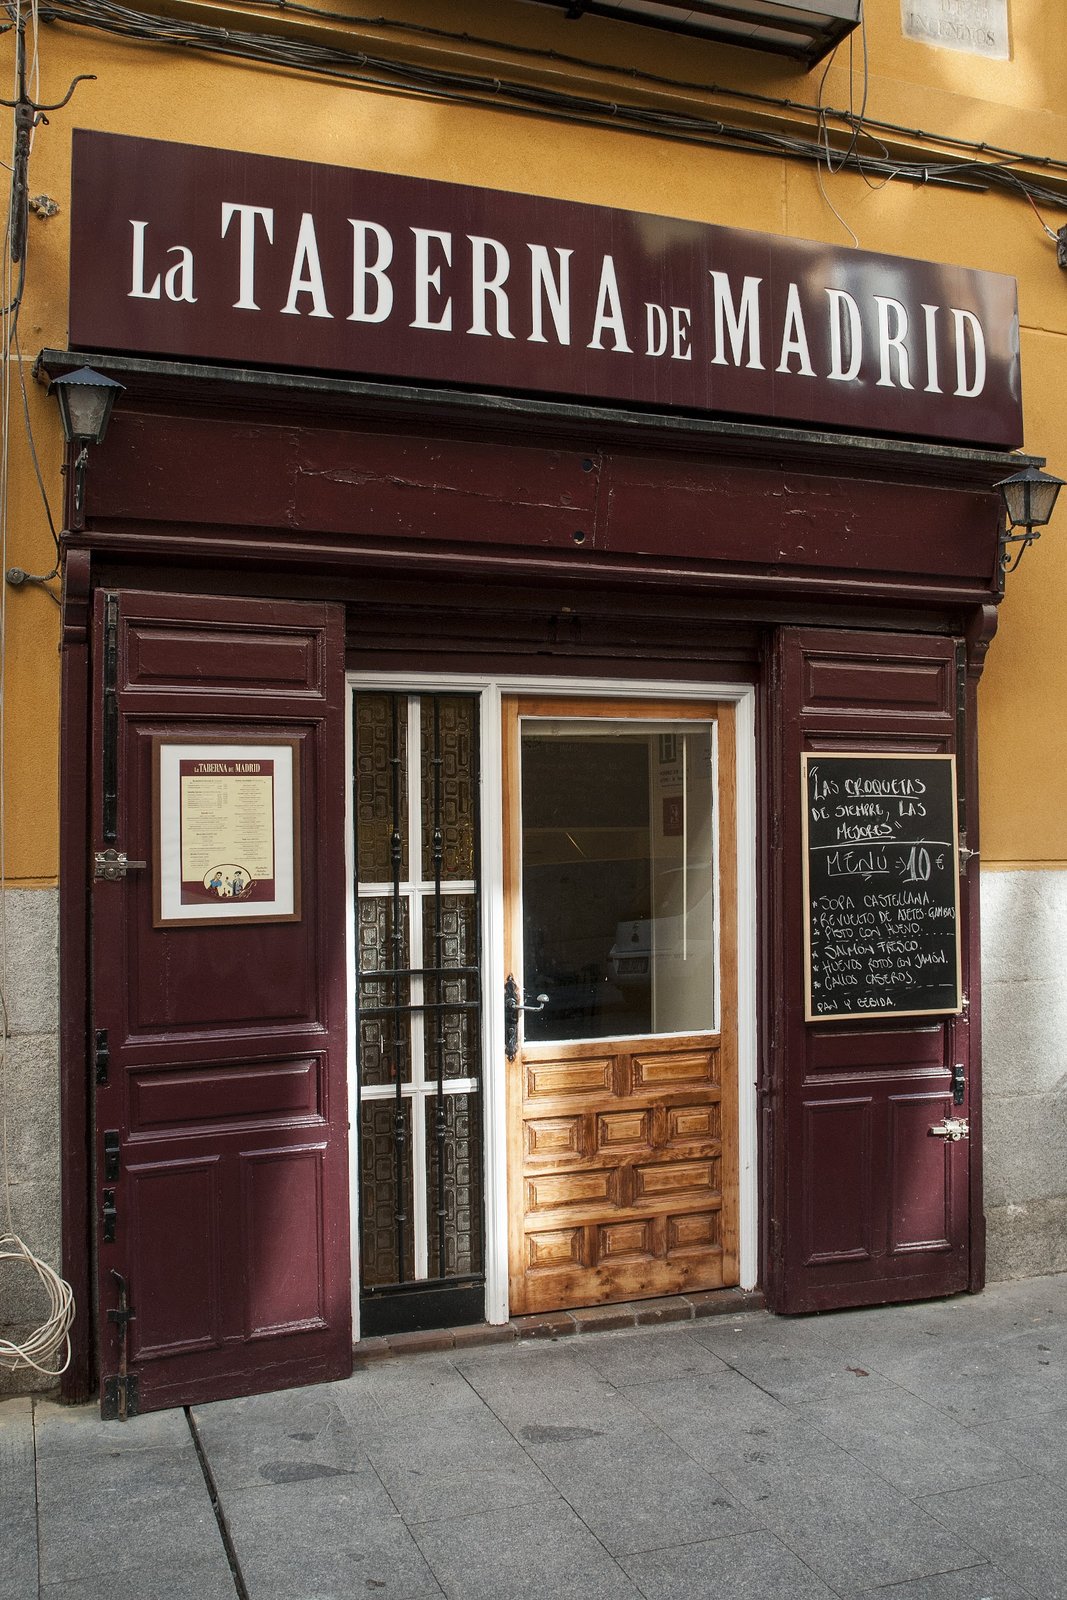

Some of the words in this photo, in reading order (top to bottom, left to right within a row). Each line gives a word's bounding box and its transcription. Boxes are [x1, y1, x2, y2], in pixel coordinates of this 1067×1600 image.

[127, 219, 198, 304] La
[221, 201, 634, 354] TABERNA
[644, 302, 692, 361] DE
[709, 270, 987, 398] MADRID
[199, 763, 228, 773] TABERNA
[235, 763, 261, 773] MADRID
[844, 777, 927, 796] CROQUETAS
[811, 807, 830, 822] DE
[899, 800, 927, 817] LAS
[827, 845, 888, 874] MENÚ
[820, 894, 855, 910] SOPA
[820, 912, 875, 927] REVUELTO
[878, 910, 892, 924] DE
[825, 925, 854, 940] PISTO
[859, 926, 881, 939] CON
[822, 959, 863, 975] HUEVOS
[868, 957, 893, 972] ROTOS
[897, 956, 911, 968] CON
[825, 974, 858, 991] CALLOS
[817, 1000, 838, 1012] PAN
[844, 999, 851, 1010] Y
